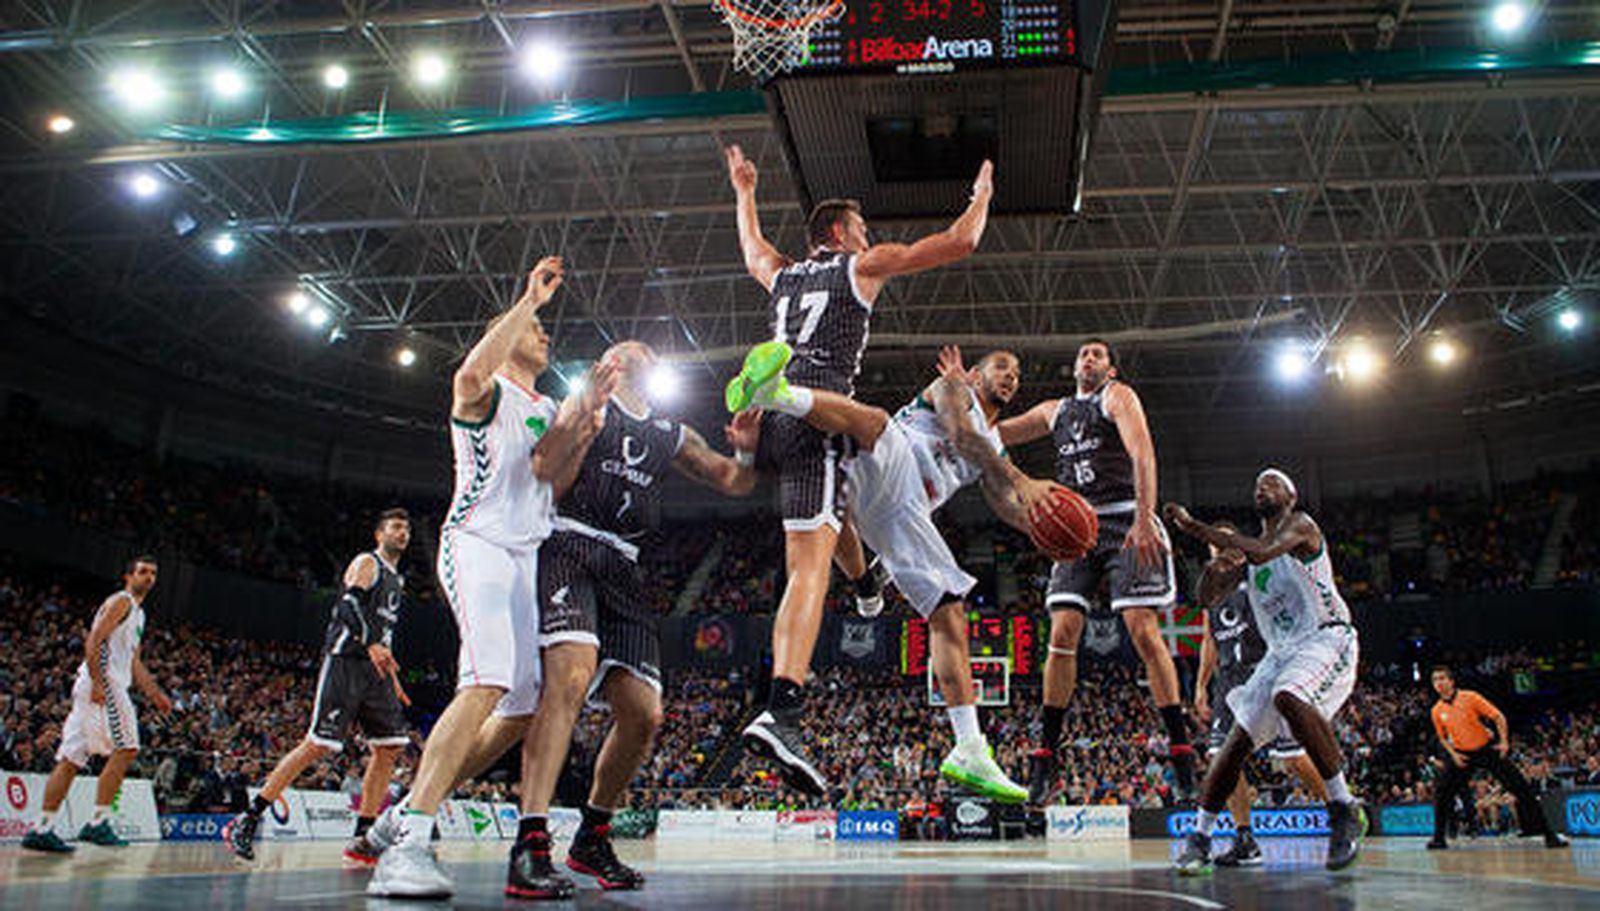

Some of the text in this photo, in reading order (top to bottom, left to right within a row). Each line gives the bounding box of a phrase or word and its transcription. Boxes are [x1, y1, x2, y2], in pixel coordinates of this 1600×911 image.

[773, 290, 829, 344] 17
[1072, 460, 1096, 486] 15
[181, 817, 218, 836] etb
[854, 817, 896, 835] IMQ
